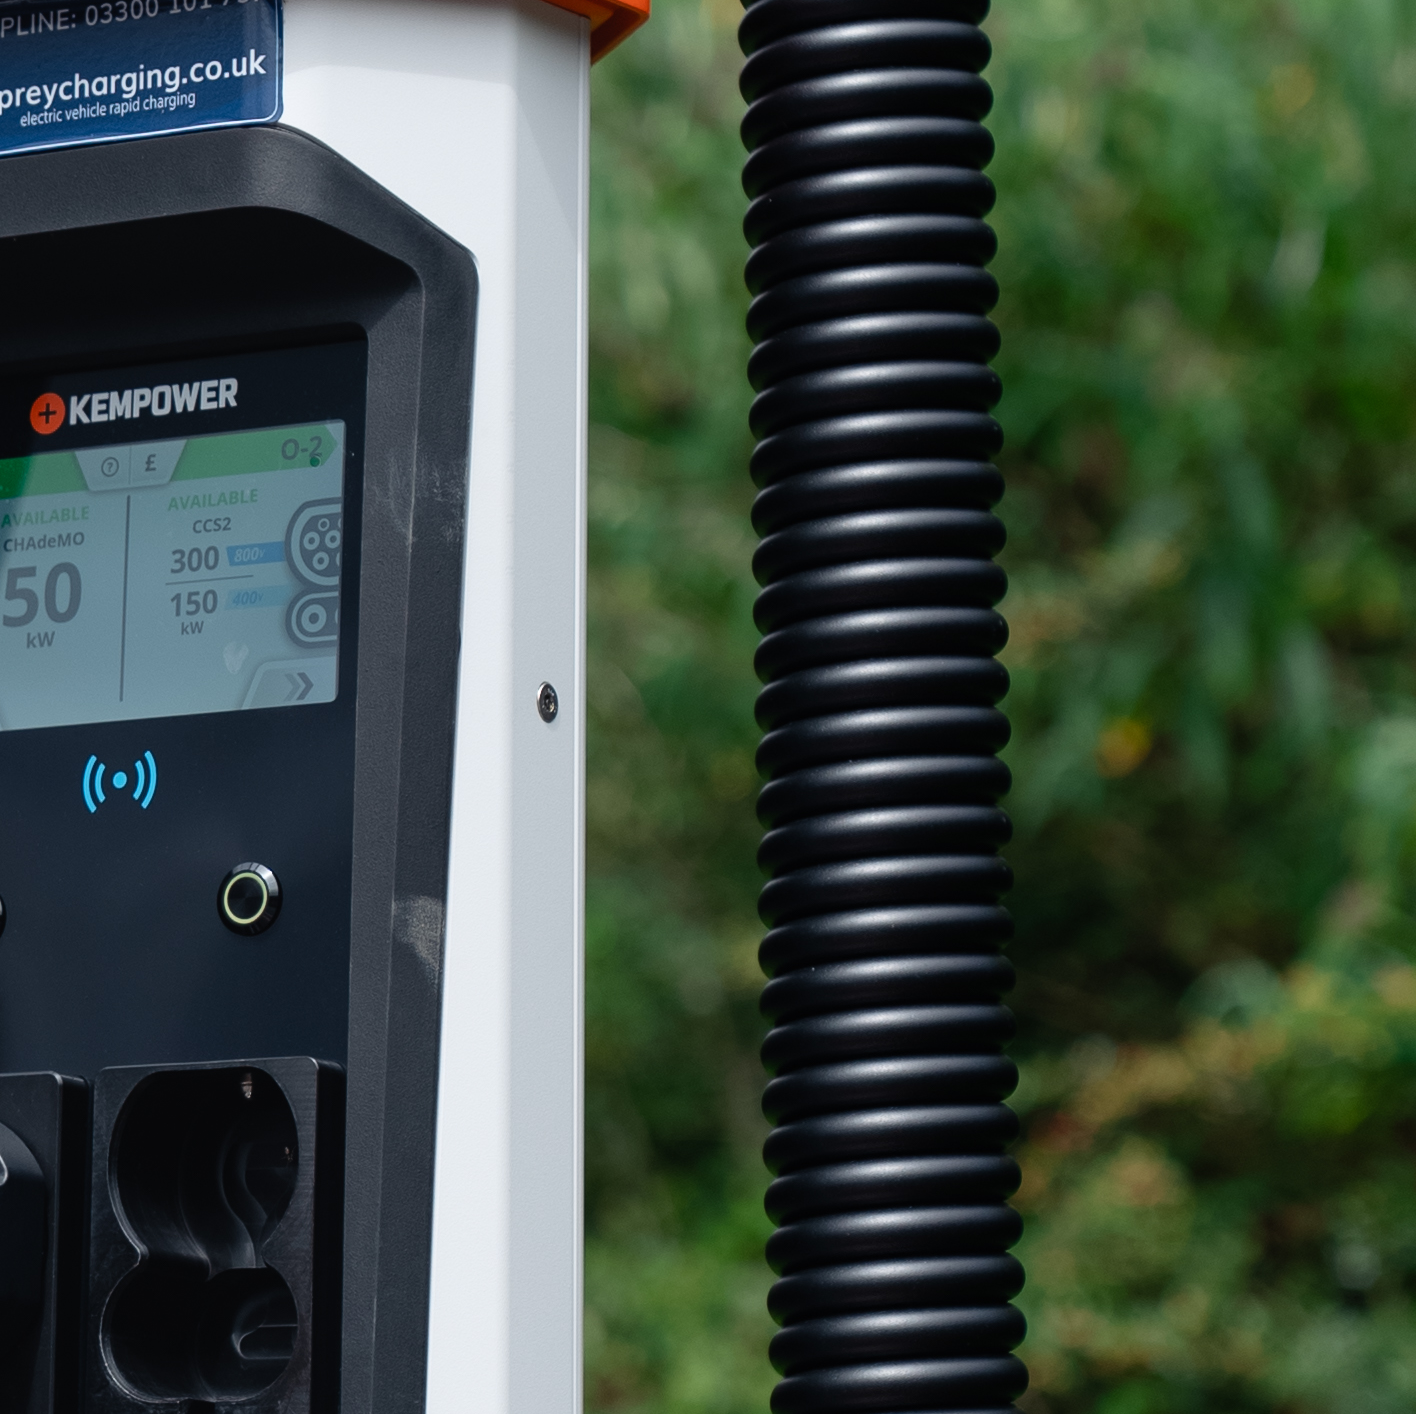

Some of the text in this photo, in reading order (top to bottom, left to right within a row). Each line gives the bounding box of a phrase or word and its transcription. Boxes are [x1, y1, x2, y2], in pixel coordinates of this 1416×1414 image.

[20, 90, 197, 128] electric vehicle rapid charging
[68, 377, 239, 426] KEMPOWER
[167, 488, 259, 512] AVAILABLE
[0, 505, 90, 529] AVAILABLE
[192, 516, 232, 535] CCS2
[3, 531, 85, 553] CHAdeMO
[170, 545, 220, 574] 300
[1, 561, 83, 629] 50
[170, 588, 219, 617] 150
[26, 631, 56, 650] kW
[180, 620, 205, 637] kW
